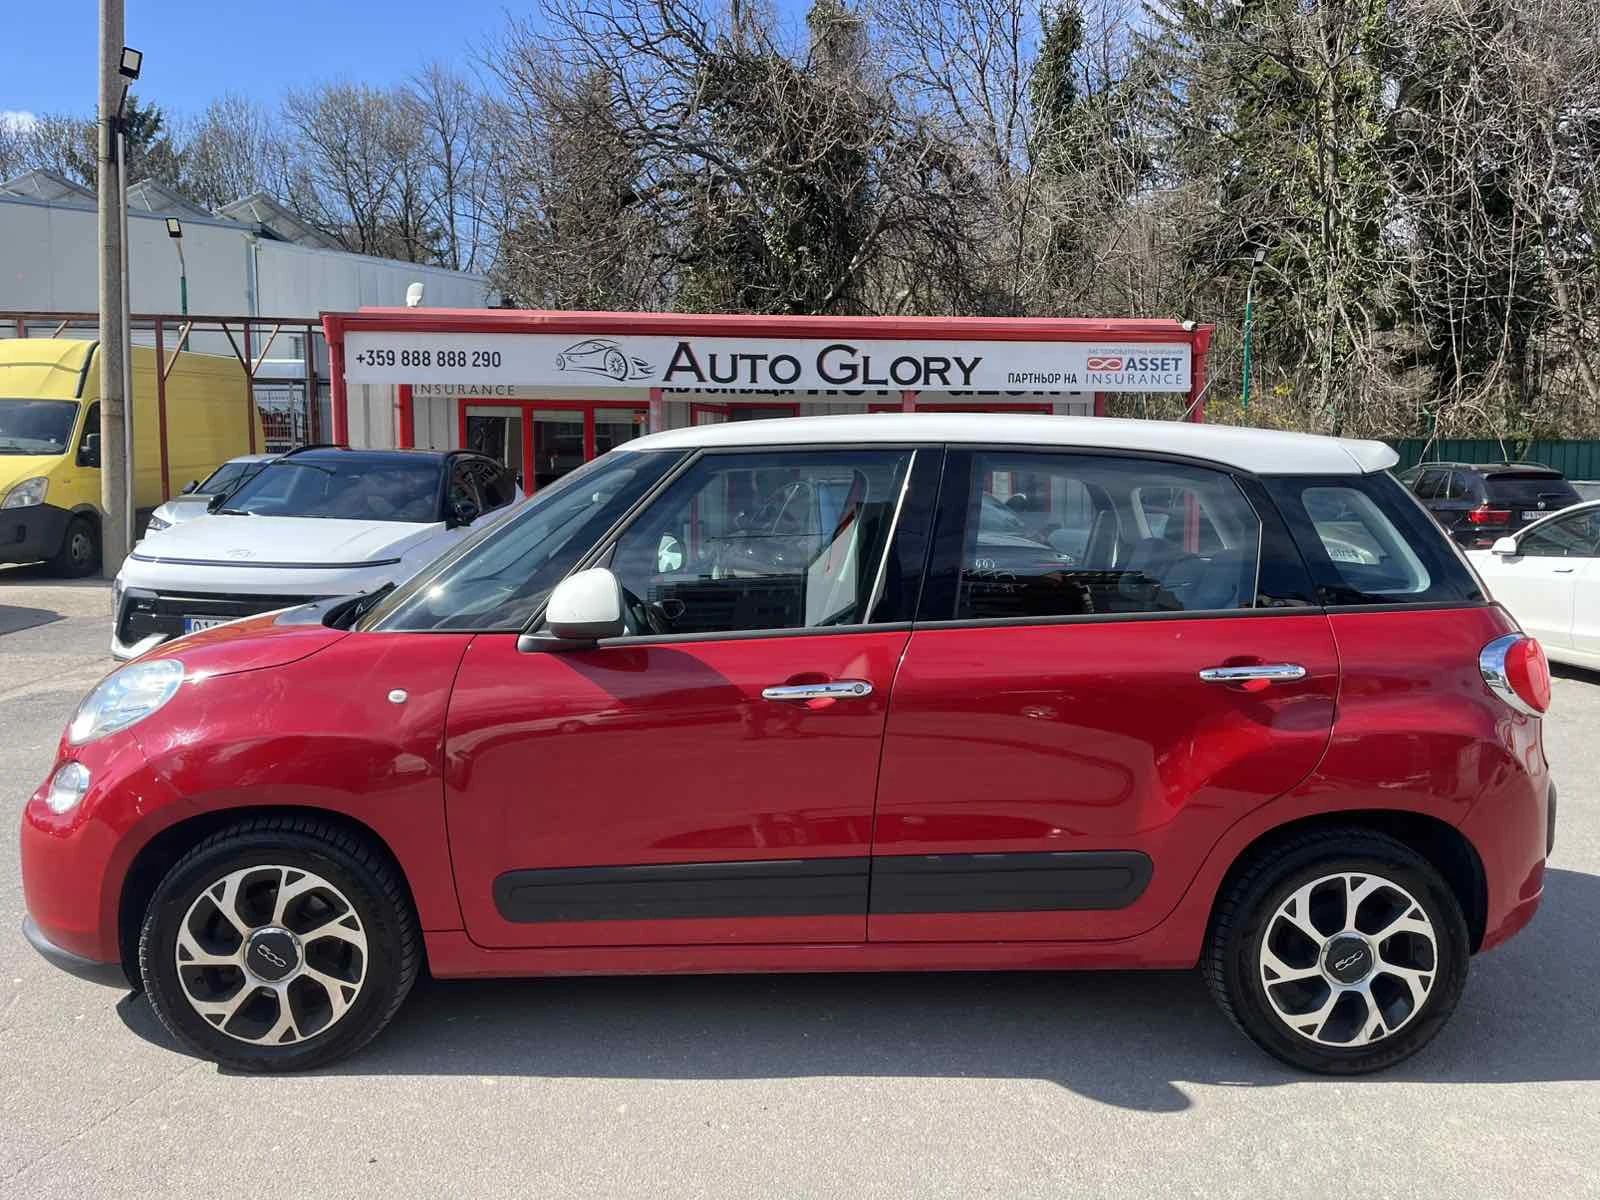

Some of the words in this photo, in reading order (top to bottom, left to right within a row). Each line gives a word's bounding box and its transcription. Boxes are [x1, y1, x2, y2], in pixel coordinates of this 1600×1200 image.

[356, 350, 396, 367] +359
[401, 350, 431, 367] 888
[437, 351, 466, 367] 888
[472, 351, 502, 367] 290
[1125, 357, 1183, 371] ASSET
[1008, 372, 1061, 384] ПАРТНЬОР
[1064, 373, 1077, 384] НА
[1086, 373, 1184, 385] INSURANCE
[414, 384, 515, 396] INSURANCE
